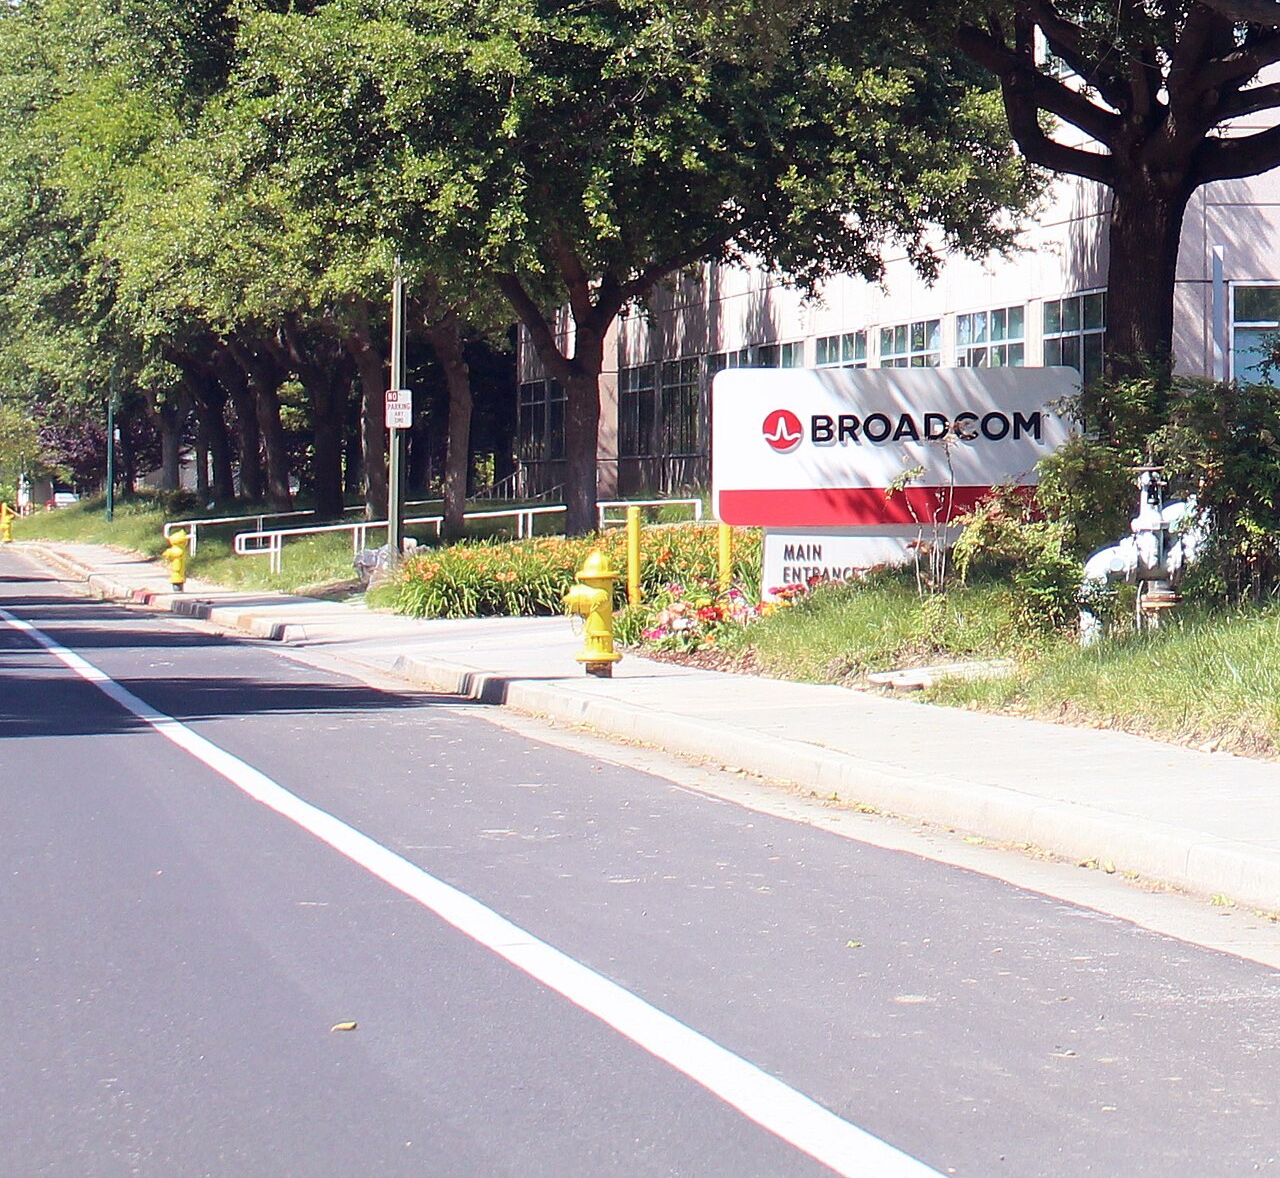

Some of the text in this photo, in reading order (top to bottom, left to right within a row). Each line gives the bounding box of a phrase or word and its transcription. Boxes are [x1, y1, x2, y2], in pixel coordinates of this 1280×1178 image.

[387, 392, 397, 401] NO
[811, 411, 1042, 442] BROADCOM
[783, 544, 822, 561] MAIN
[783, 566, 861, 584] ENTRANC
